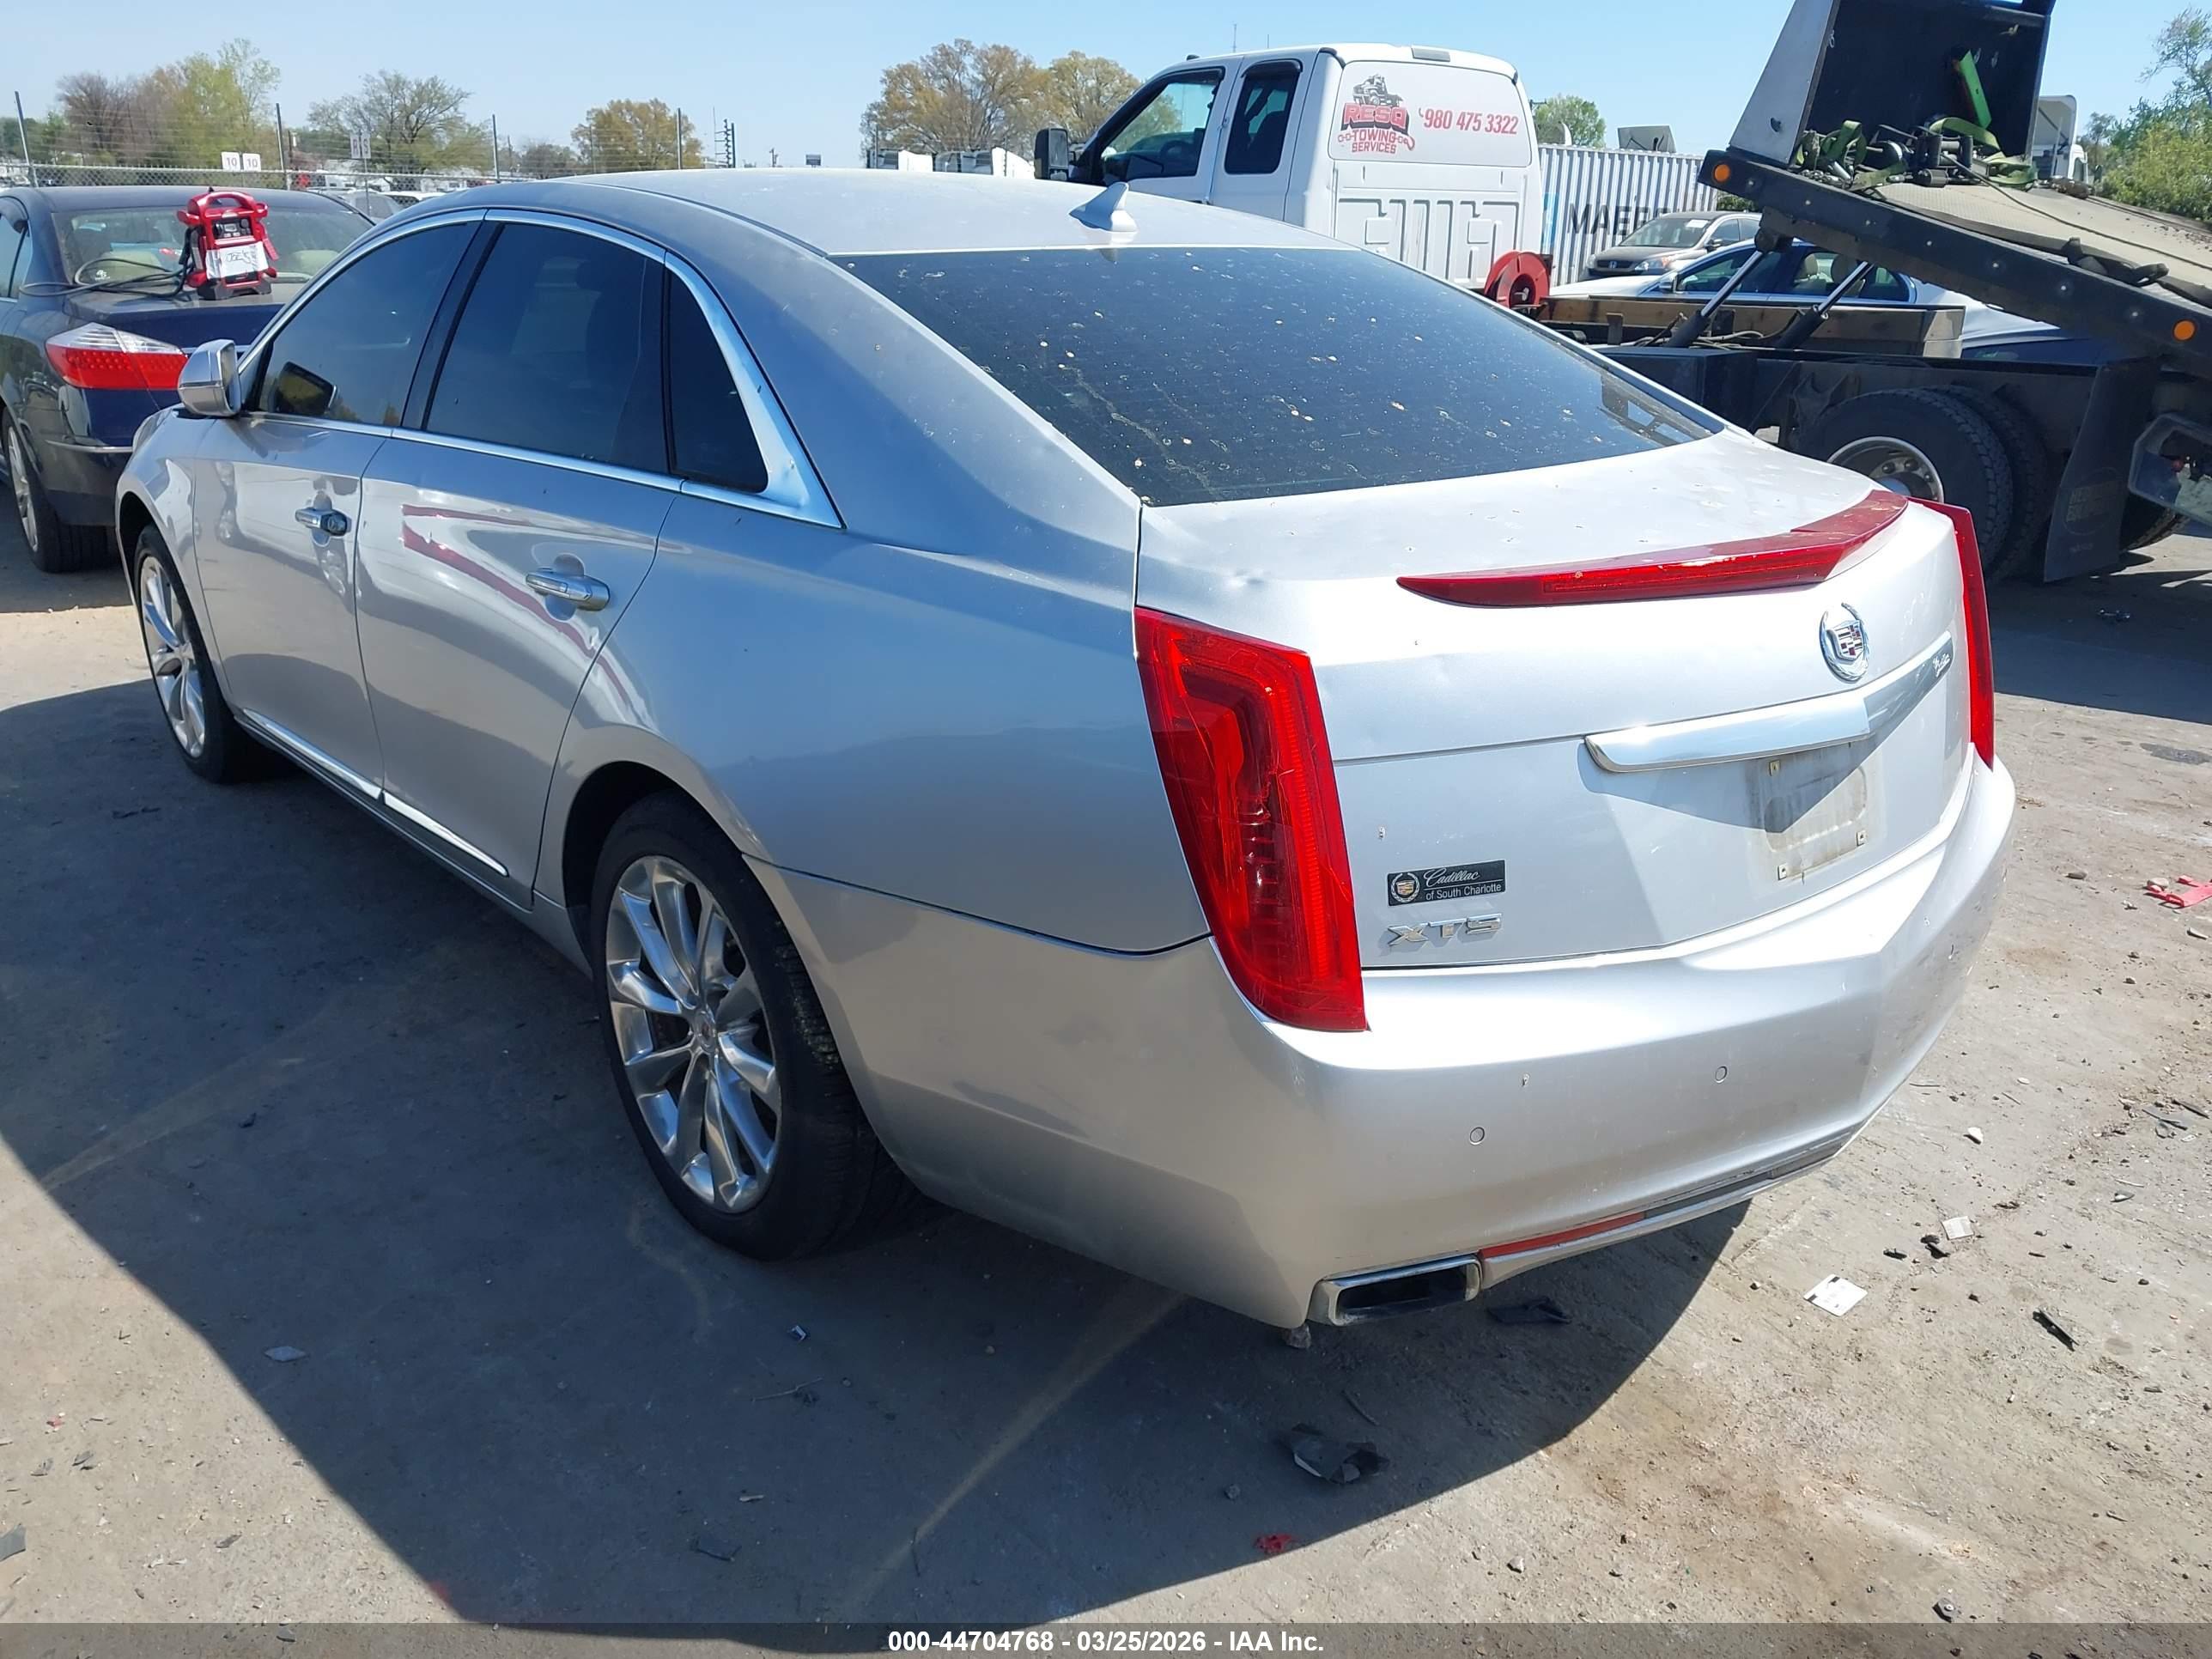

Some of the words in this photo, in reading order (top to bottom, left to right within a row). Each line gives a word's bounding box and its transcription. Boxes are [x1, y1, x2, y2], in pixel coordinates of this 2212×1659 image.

[1343, 102, 1408, 129] RESQ
[1424, 108, 1451, 130] 980
[1456, 113, 1482, 131] 475
[1485, 114, 1519, 134] 3322
[1352, 129, 1396, 143] TOWING
[1352, 142, 1396, 155] SERVICES
[226, 157, 237, 167] 10
[247, 158, 258, 168] 10
[1423, 867, 1480, 888] Cadillac
[1425, 890, 1436, 901] of
[1437, 886, 1462, 900] South
[1463, 883, 1502, 896] Charlotte
[1388, 913, 1503, 946] XTS
